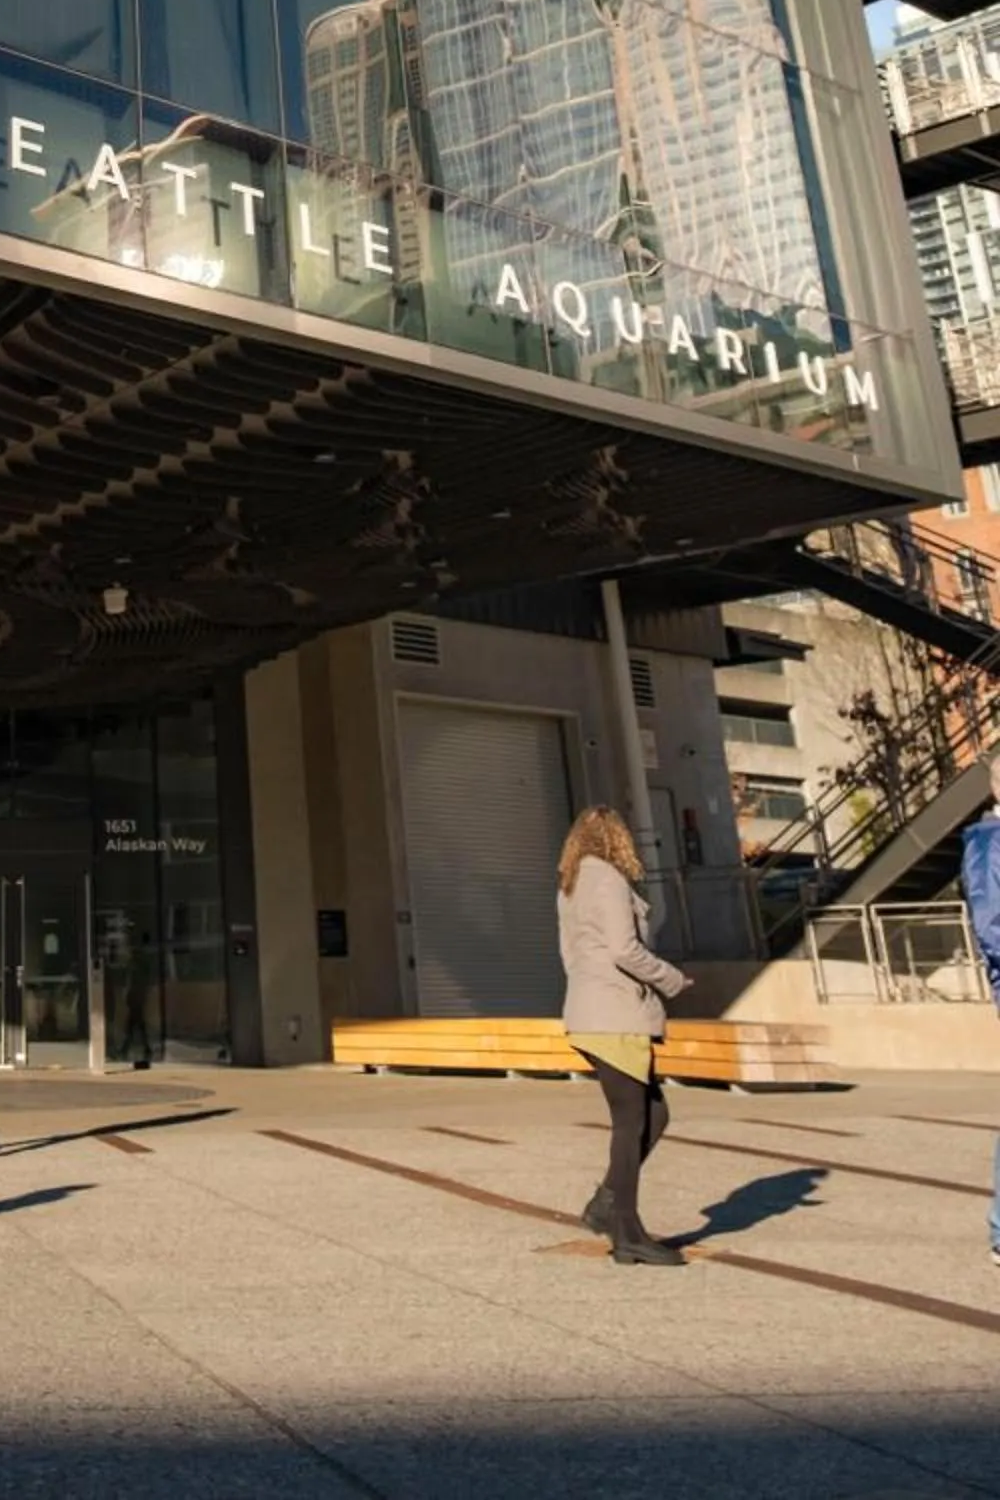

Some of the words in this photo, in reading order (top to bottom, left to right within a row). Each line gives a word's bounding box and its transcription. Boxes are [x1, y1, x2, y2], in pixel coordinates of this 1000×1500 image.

[495, 263, 879, 410] AQUARIUM
[104, 819, 136, 833] 1651
[106, 837, 167, 851] Alaskan
[172, 838, 206, 853] Way
